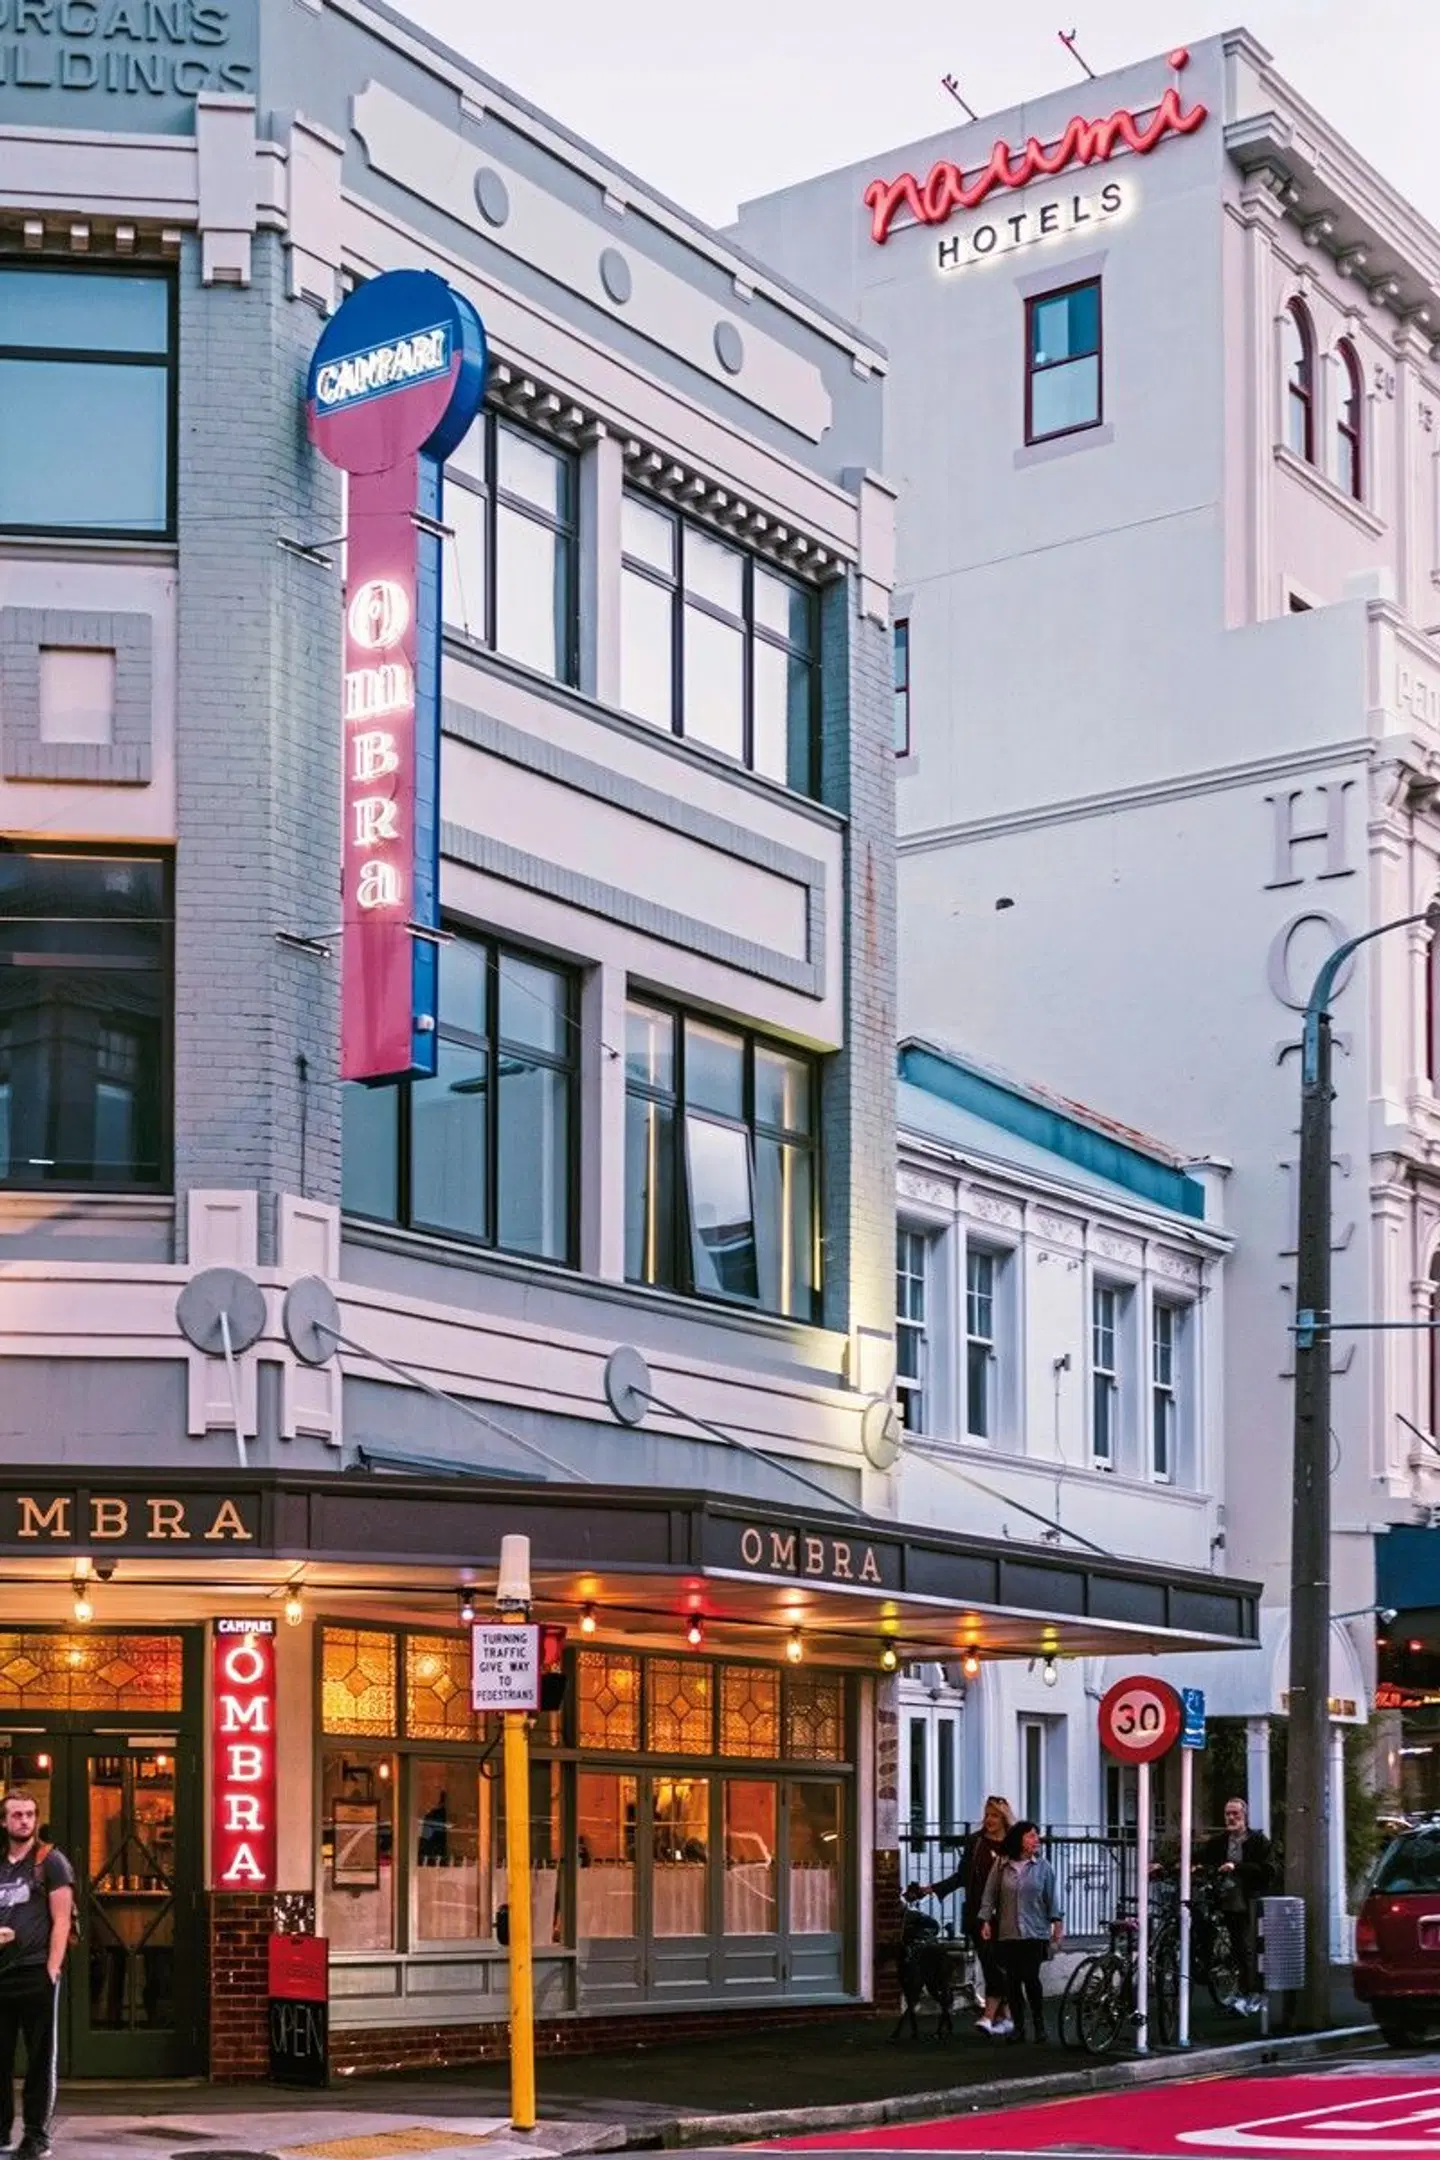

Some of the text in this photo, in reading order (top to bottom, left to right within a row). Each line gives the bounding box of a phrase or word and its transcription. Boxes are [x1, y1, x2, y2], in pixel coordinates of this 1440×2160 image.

[0, 0, 229, 46] RGAN'S
[864, 46, 1208, 245] naumi
[938, 184, 1123, 268] HOTELS
[316, 329, 446, 404] CAMPARI
[17, 1497, 253, 1539] MBRA
[741, 1528, 882, 1583] OMBRA
[218, 1619, 273, 1633] CAMPARI
[482, 1633, 528, 1644] TURNING
[479, 1662, 531, 1673] GIVE WAY
[484, 1647, 526, 1658] TRAFFIC
[476, 1689, 534, 1701] PEDESTRIANS
[499, 1675, 512, 1686] TO
[1116, 1703, 1160, 1735] 30
[220, 1646, 270, 1881] OMBRA
[271, 2003, 324, 2063] OPEN
